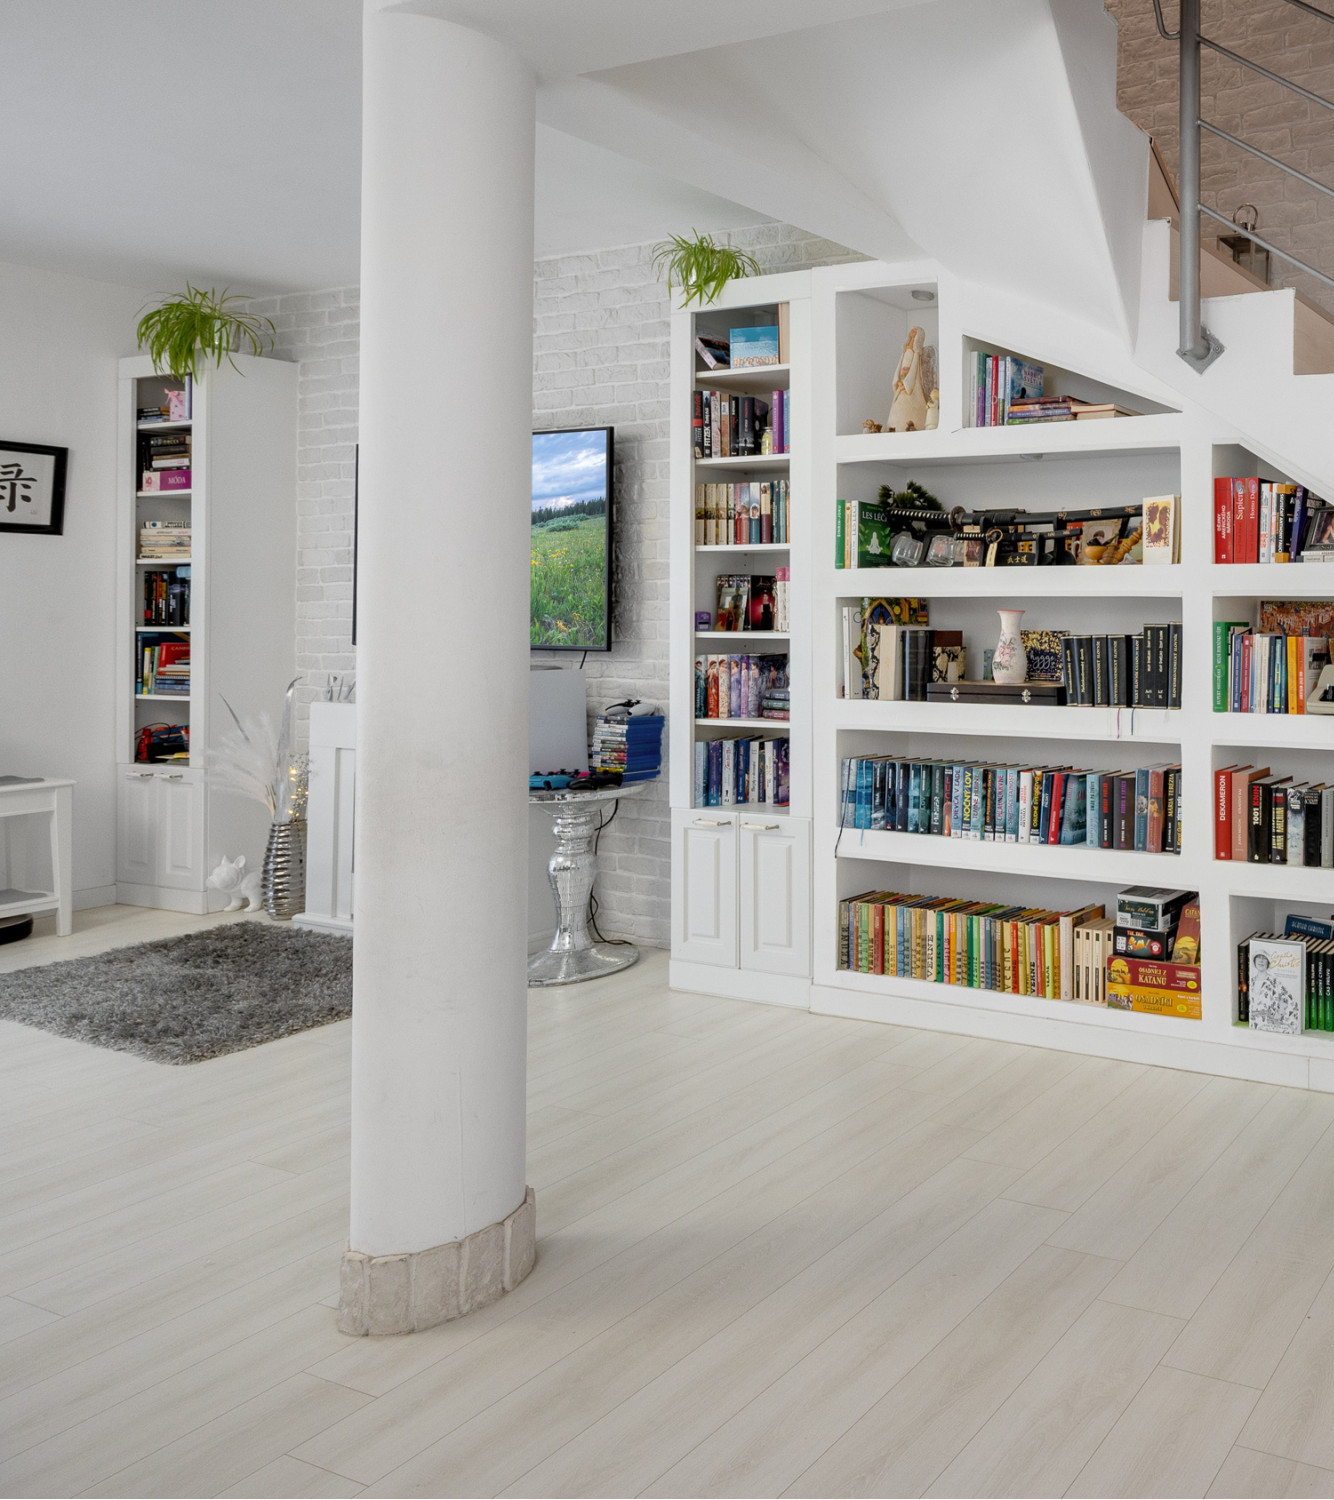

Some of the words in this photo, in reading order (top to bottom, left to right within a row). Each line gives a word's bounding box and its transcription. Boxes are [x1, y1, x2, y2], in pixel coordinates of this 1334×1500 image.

[168, 475, 186, 485] MÓDA
[1236, 487, 1244, 520] Sapiens
[862, 511, 872, 520] LES
[1030, 650, 1055, 669] hygge
[963, 771, 972, 788] LOV
[1166, 773, 1174, 796] TERÉZIA
[963, 791, 972, 821] NOČNÝ
[1166, 799, 1174, 817] MÁRIA
[1138, 967, 1162, 975] OSADNÍCI
[1138, 975, 1167, 986] KATANU
[1135, 994, 1173, 1007] OSADNÍCI
